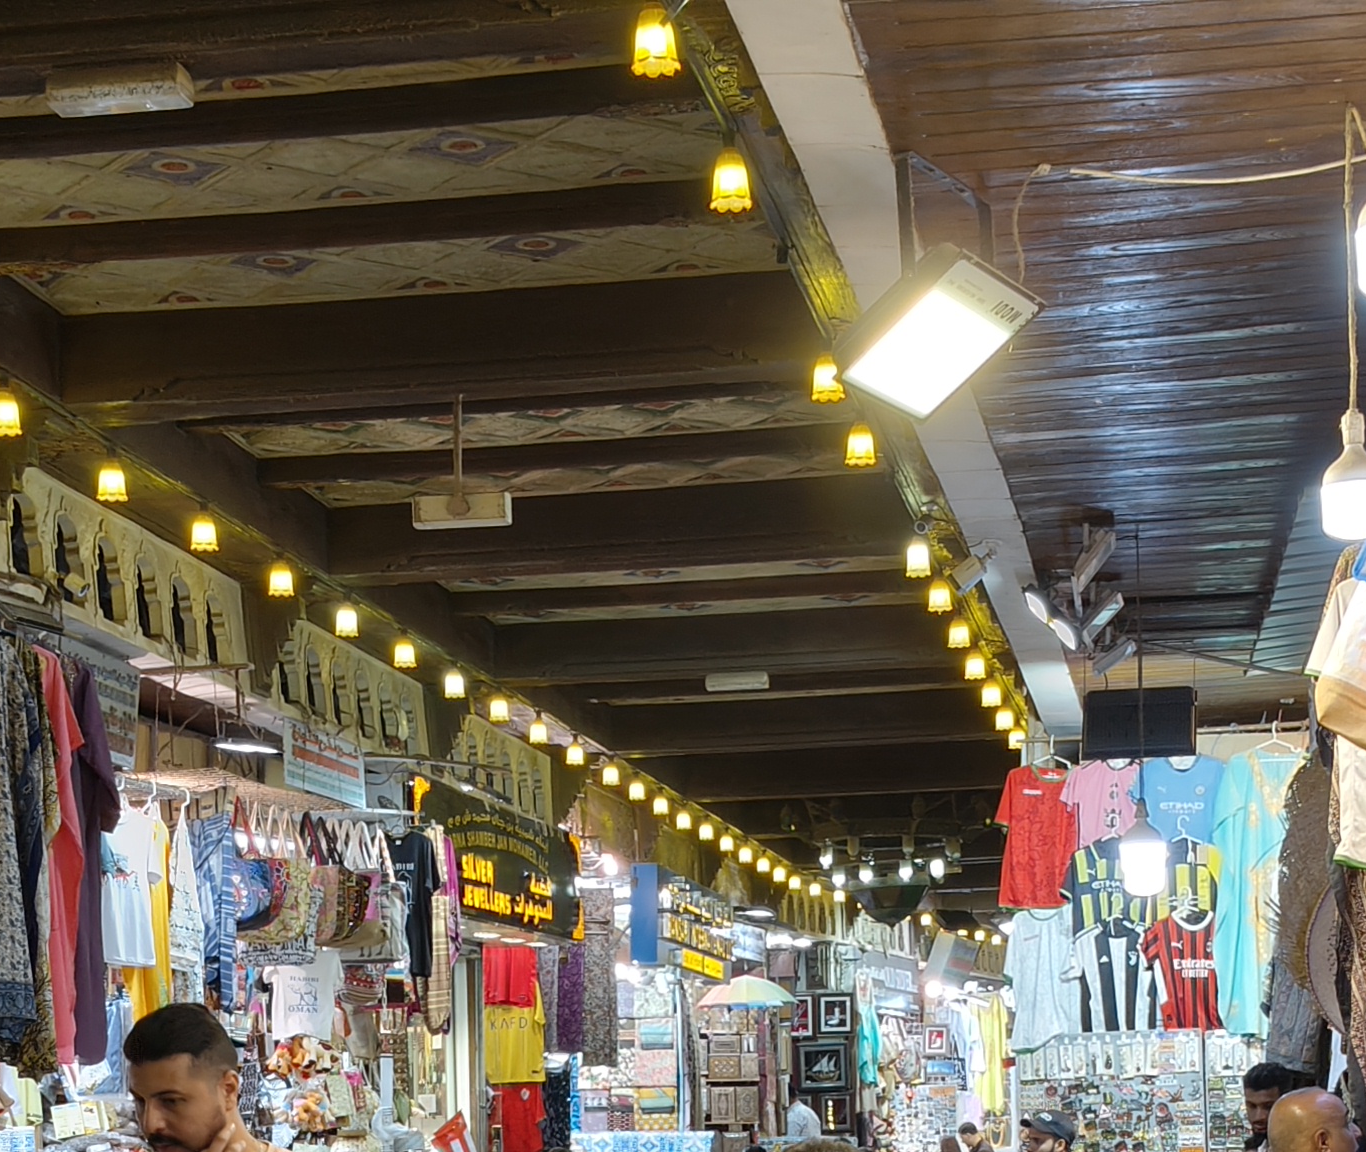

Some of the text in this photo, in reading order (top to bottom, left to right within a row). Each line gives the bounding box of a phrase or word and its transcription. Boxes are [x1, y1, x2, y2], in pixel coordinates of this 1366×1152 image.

[1160, 802, 1204, 810] ETIHAD
[462, 853, 494, 885] SILVER
[462, 884, 512, 916] JEWELLERS
[288, 1006, 318, 1014] OMAN
[490, 1017, 528, 1031] KAFD
